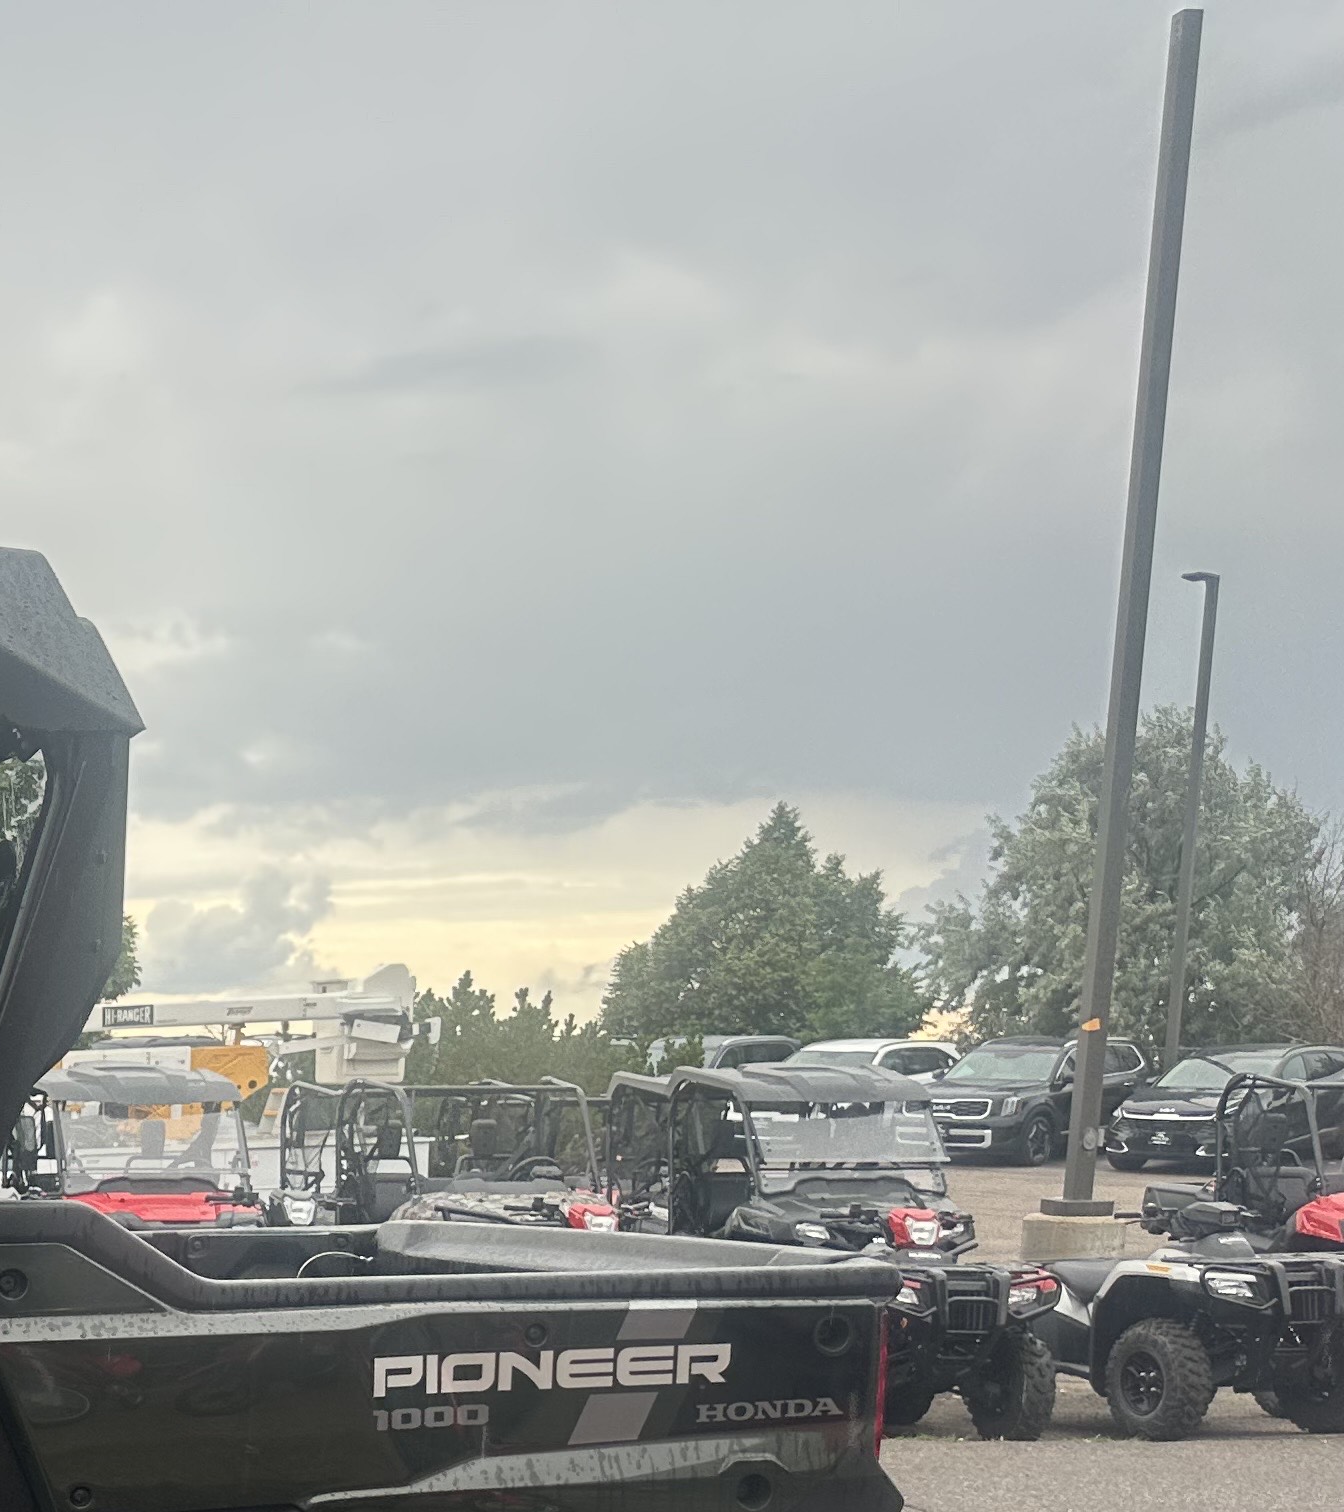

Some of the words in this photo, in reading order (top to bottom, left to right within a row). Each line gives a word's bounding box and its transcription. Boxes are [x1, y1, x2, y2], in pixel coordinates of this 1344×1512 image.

[104, 1006, 152, 1026] HI-RANGER
[372, 1343, 731, 1398] PIONEER
[373, 1404, 490, 1431] 1000
[695, 1397, 844, 1424] HONDA
